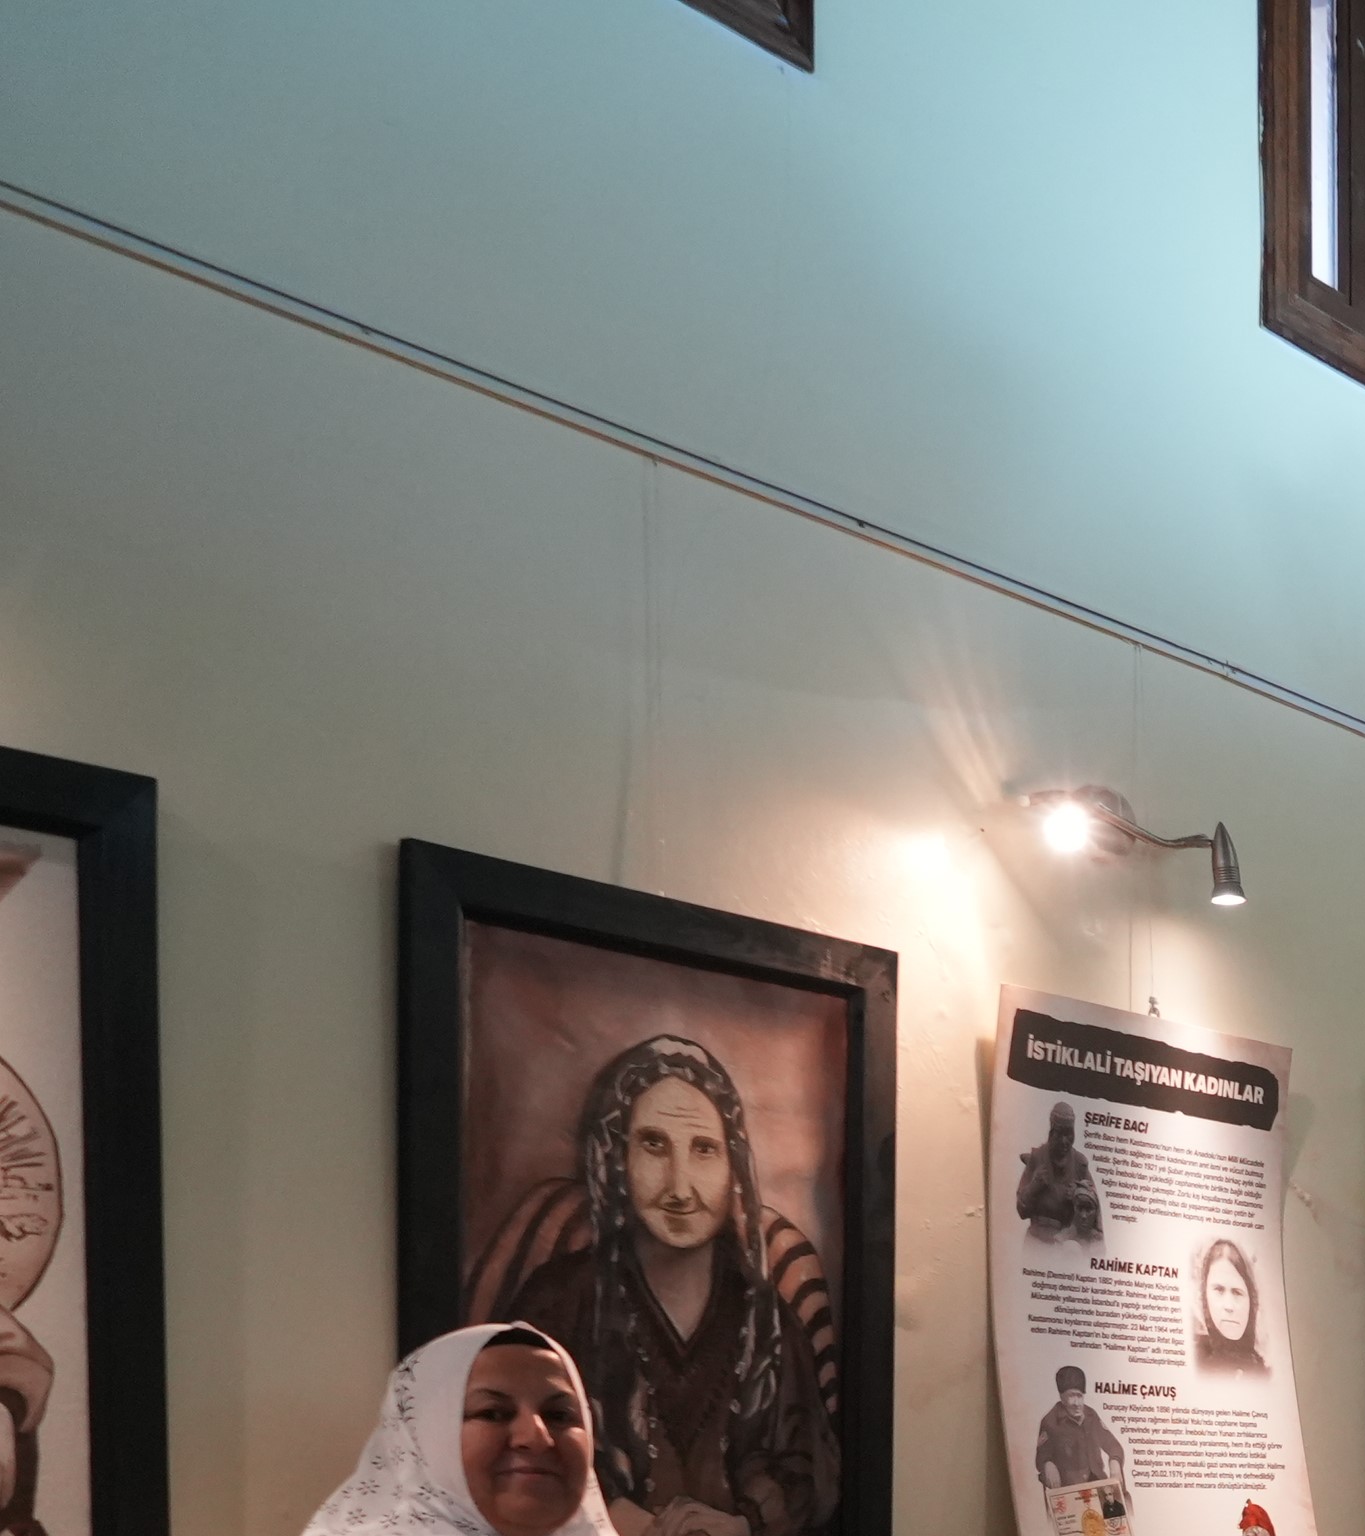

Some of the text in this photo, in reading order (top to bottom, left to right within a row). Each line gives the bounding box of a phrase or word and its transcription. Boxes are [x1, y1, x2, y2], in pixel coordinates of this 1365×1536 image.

[1027, 1033, 1265, 1105] İSTİKLALİ TAŞIYAN KADINLAR
[1083, 1111, 1149, 1135] ŞERİFE BACI
[1090, 1257, 1179, 1279] RAHİME KAPTAN
[1094, 1379, 1177, 1402] HALİME ÇAVUŞ
